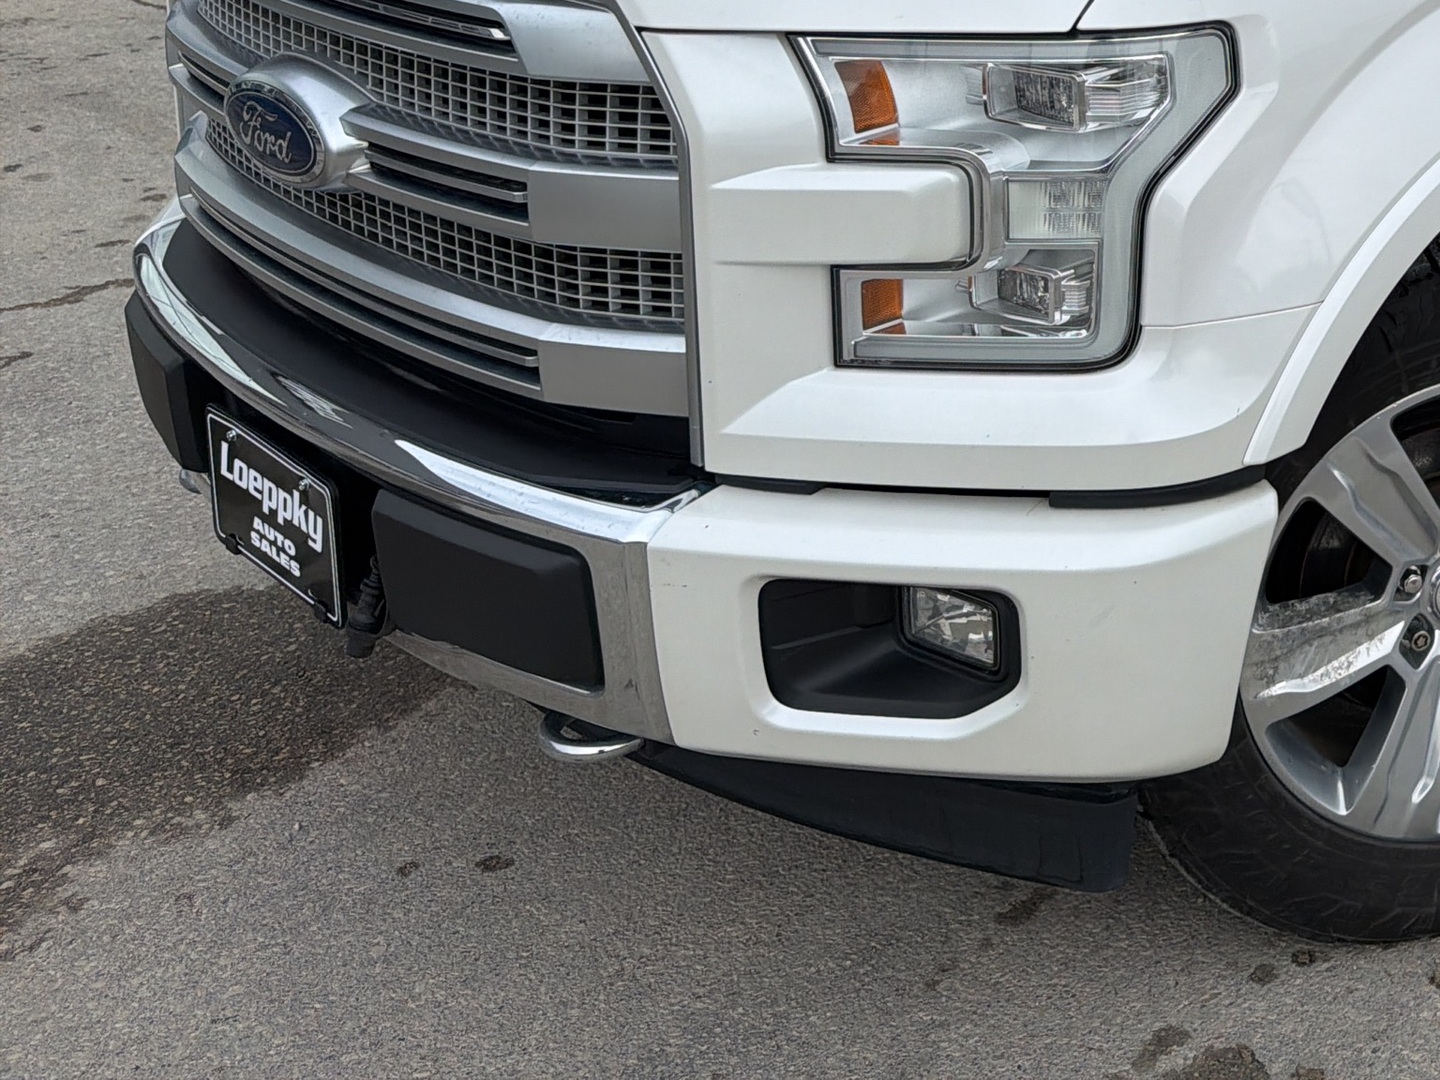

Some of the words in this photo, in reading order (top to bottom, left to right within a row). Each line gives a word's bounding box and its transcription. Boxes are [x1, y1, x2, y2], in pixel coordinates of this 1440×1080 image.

[239, 100, 293, 164] Ford
[220, 441, 323, 553] Loeppky
[251, 531, 301, 578] SALES
[253, 516, 296, 556] AUTO
